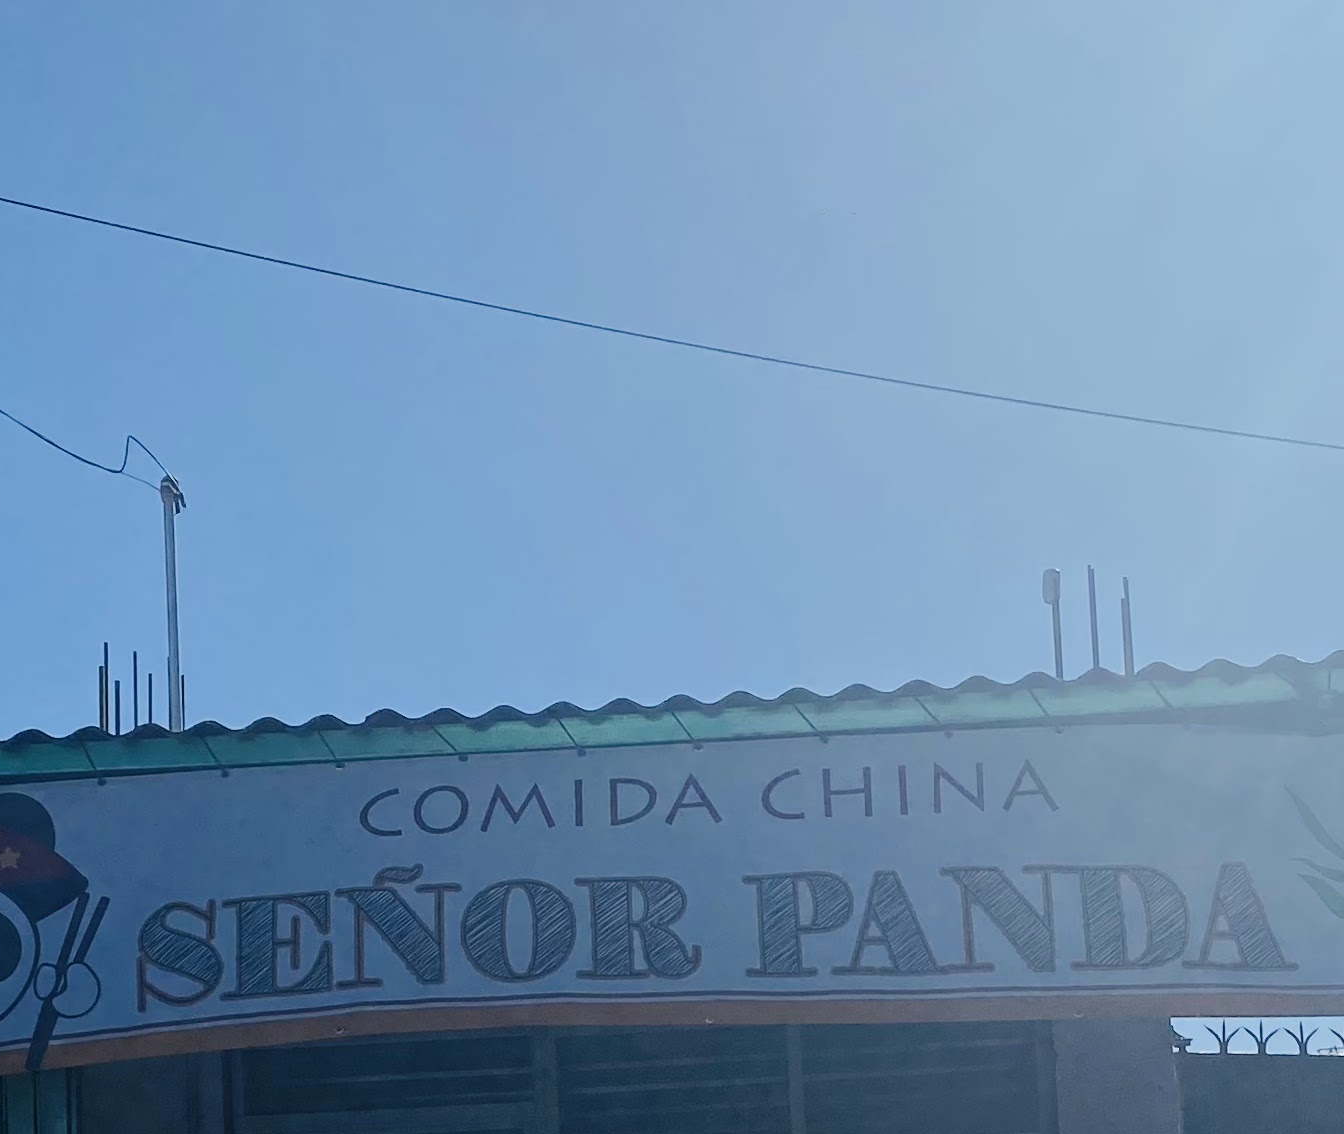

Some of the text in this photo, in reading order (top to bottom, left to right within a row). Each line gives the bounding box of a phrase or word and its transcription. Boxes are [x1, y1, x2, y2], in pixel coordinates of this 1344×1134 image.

[359, 758, 1061, 837] COMIDA CHINA
[136, 861, 1300, 1013] SEÑOR PANDA
